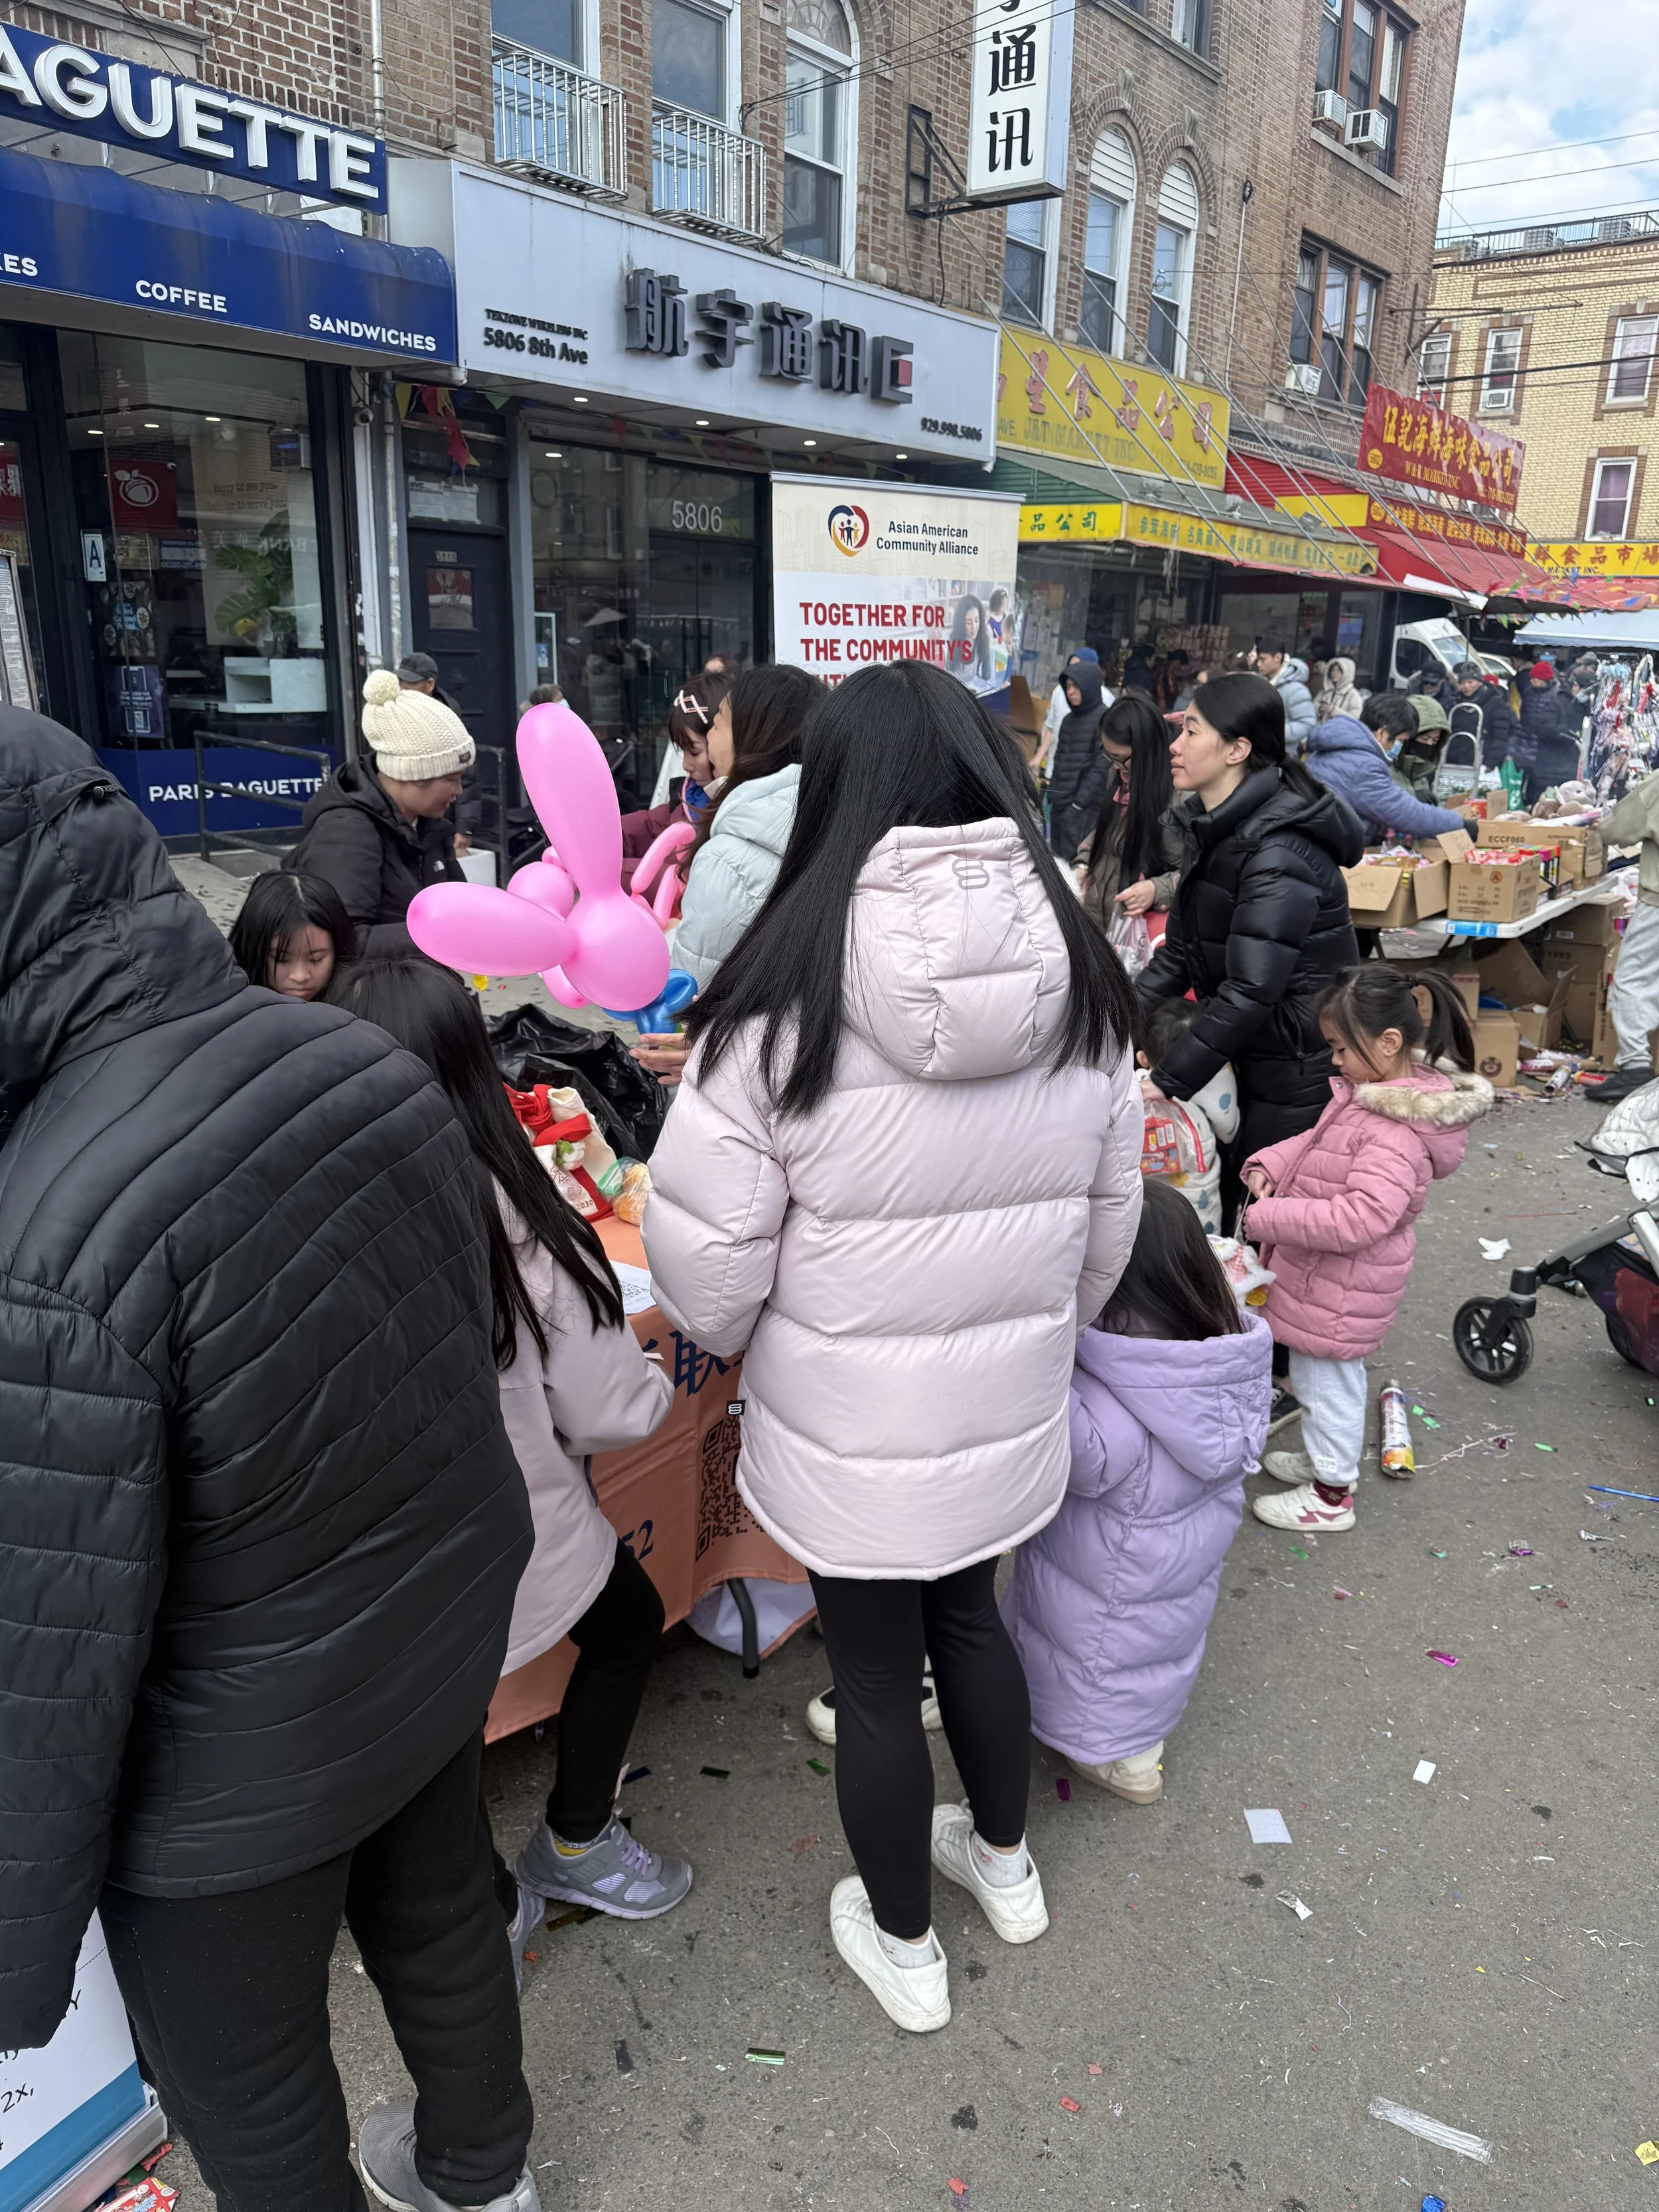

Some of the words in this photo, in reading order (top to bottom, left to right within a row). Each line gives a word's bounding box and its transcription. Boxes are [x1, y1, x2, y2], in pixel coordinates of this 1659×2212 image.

[985, 0, 1036, 173] 通讯
[0, 25, 379, 198] AGUETTE
[0, 253, 38, 277] ES
[135, 279, 227, 313] COFFEE
[309, 313, 436, 351] SANDWICHES
[484, 309, 528, 327] TEKZONE
[625, 268, 868, 394] 航宇通讯
[484, 327, 525, 352] 5806
[528, 336, 555, 358] 8th
[559, 342, 588, 364] Ave
[672, 500, 722, 533] 5806
[889, 521, 918, 534] Asian
[922, 523, 968, 538] American
[1019, 510, 1097, 532] 品公司
[877, 537, 937, 555] Community
[939, 541, 978, 555] Alliance
[799, 602, 906, 627] TOGETHER
[912, 605, 946, 628] FOR
[800, 638, 841, 662] THE
[846, 638, 973, 662] COMMUNITY'S
